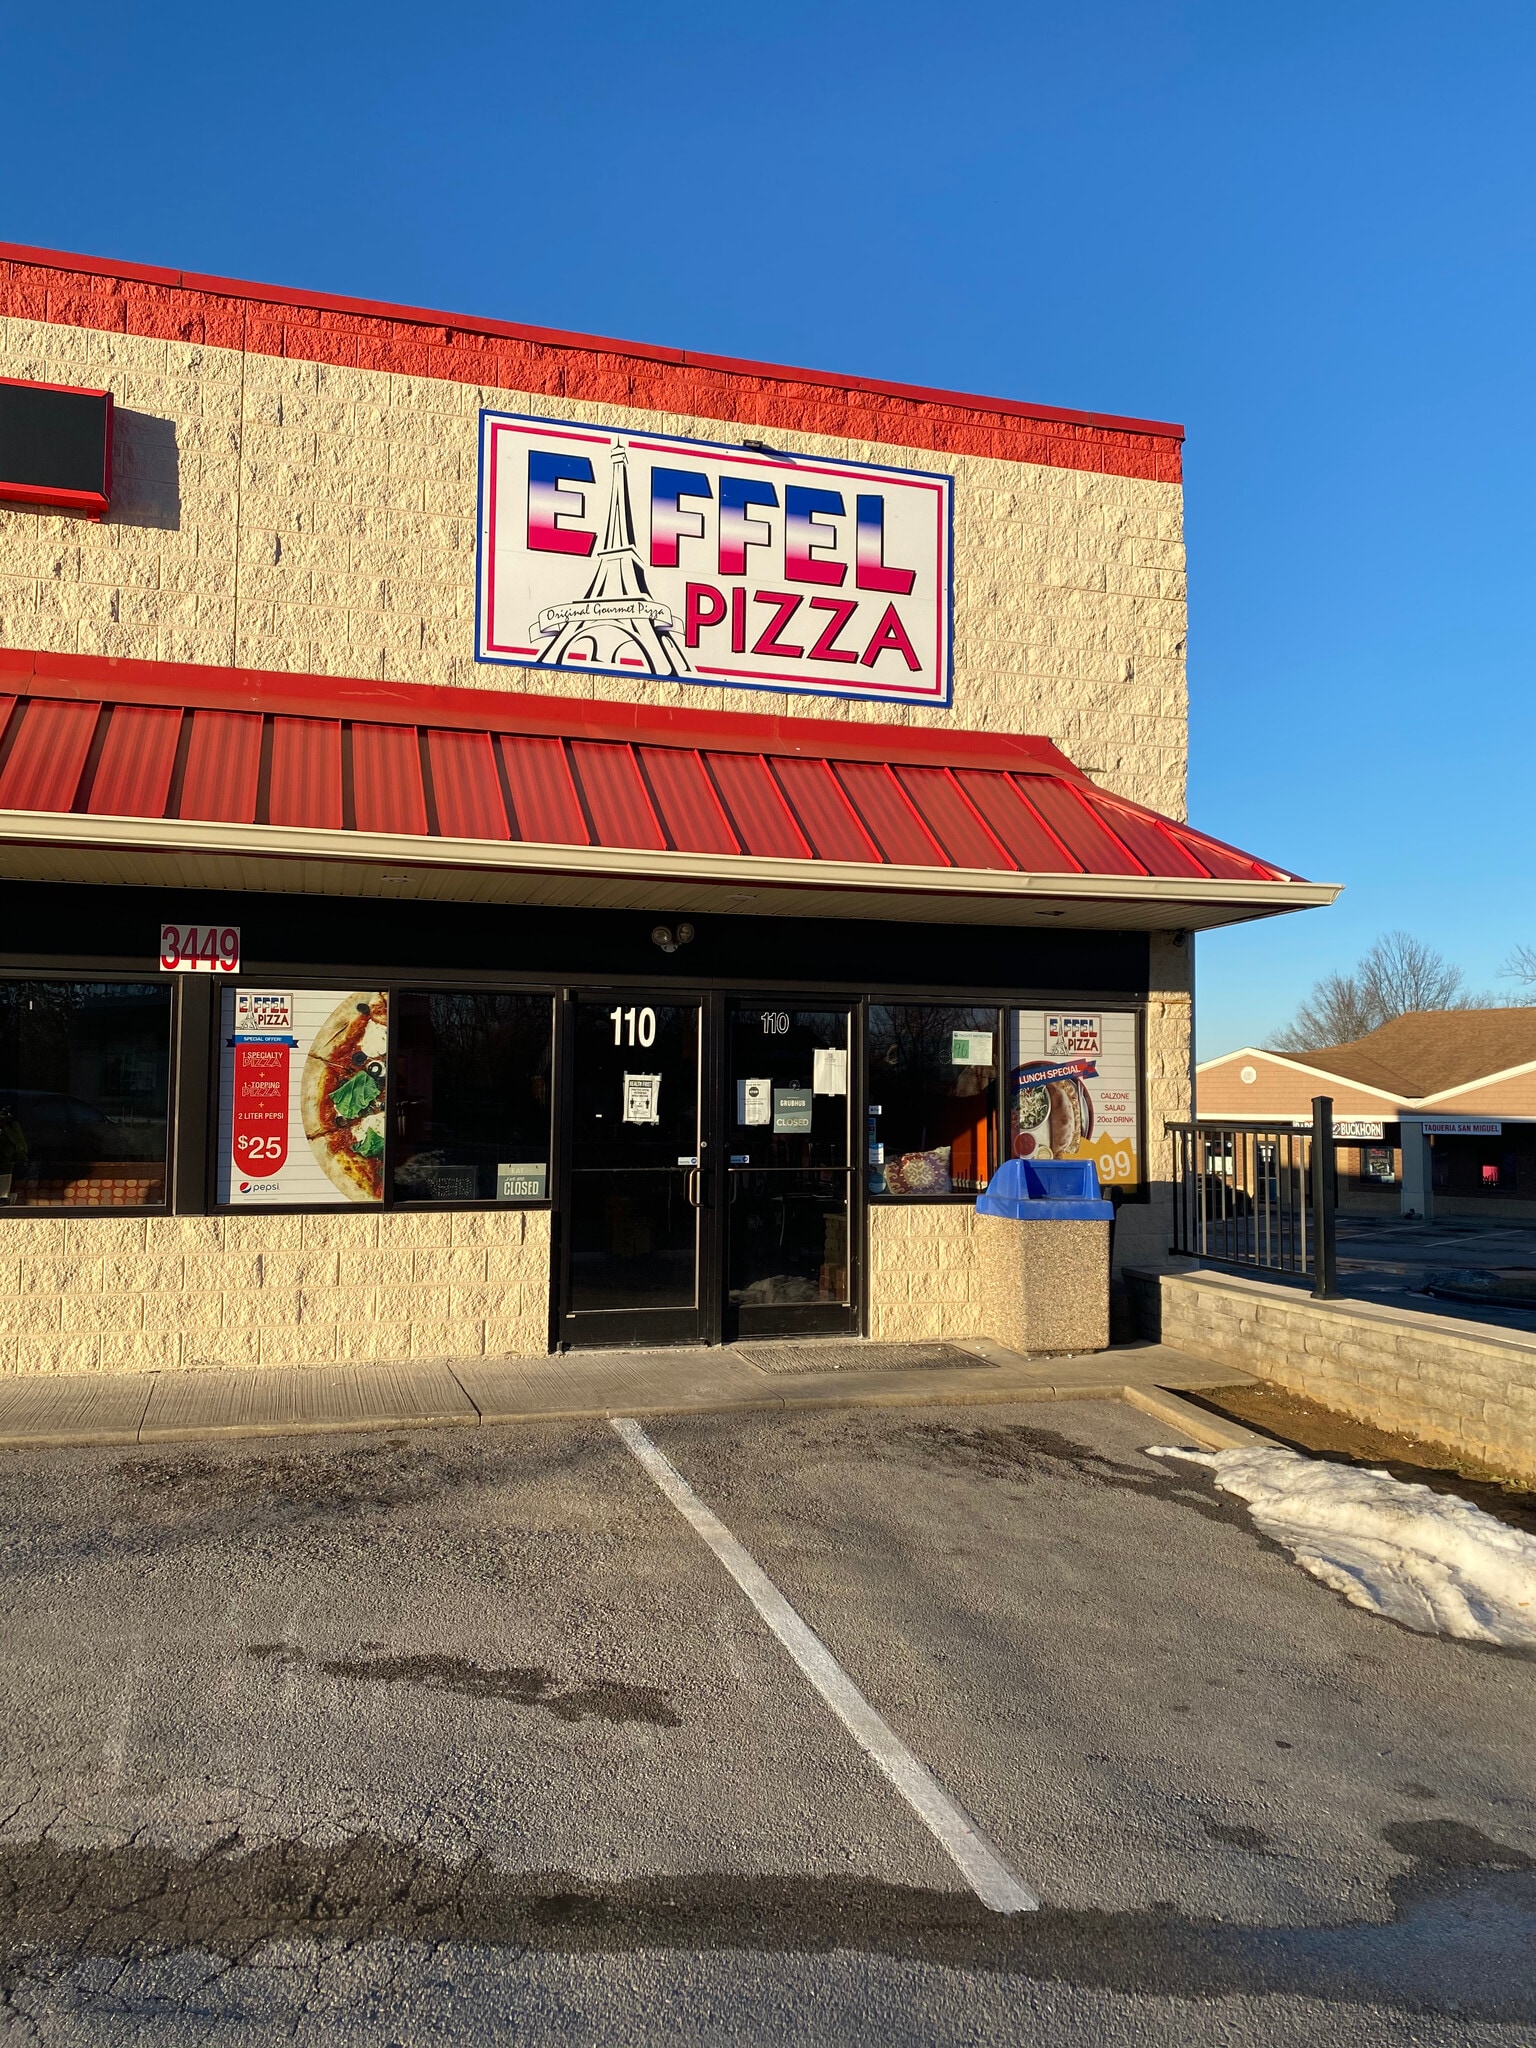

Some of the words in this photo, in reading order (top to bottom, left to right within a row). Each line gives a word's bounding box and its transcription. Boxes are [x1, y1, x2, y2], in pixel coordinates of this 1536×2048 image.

[546, 604, 590, 621] Original
[593, 602, 635, 616] Gourmet
[637, 602, 665, 619] Pizza
[684, 581, 922, 672] PIZZA
[161, 926, 240, 971] 3449
[257, 1014, 289, 1026] PIZZA
[760, 1012, 790, 1034] 110
[610, 1006, 656, 1048] 110
[1067, 1038, 1099, 1051] PIZZA
[247, 1051, 283, 1059] SPECIALTY
[242, 1058, 282, 1068] PIZZA
[1018, 1072, 1046, 1085] LUNCH
[1046, 1064, 1081, 1079] SPECIAL
[241, 1087, 282, 1097] PIZZA
[1100, 1092, 1130, 1100] CALZONE
[780, 1099, 806, 1107] GRUBHUB
[1104, 1104, 1126, 1112] SALAD
[238, 1112, 243, 1120] 2
[244, 1112, 264, 1120] LITER
[264, 1112, 284, 1120] PEPSI
[1096, 1115, 1112, 1124] 20oz
[1113, 1116, 1134, 1124] DRINK
[776, 1118, 809, 1127] CLOSED
[1340, 1122, 1382, 1137] BUCKHORN
[1424, 1124, 1456, 1133] TAQUERIA
[1457, 1124, 1471, 1132] SAN
[1472, 1124, 1500, 1133] MIGUEL
[237, 1134, 282, 1159] $25
[253, 1182, 280, 1193] pepsi
[503, 1181, 540, 1196] CLOSED
